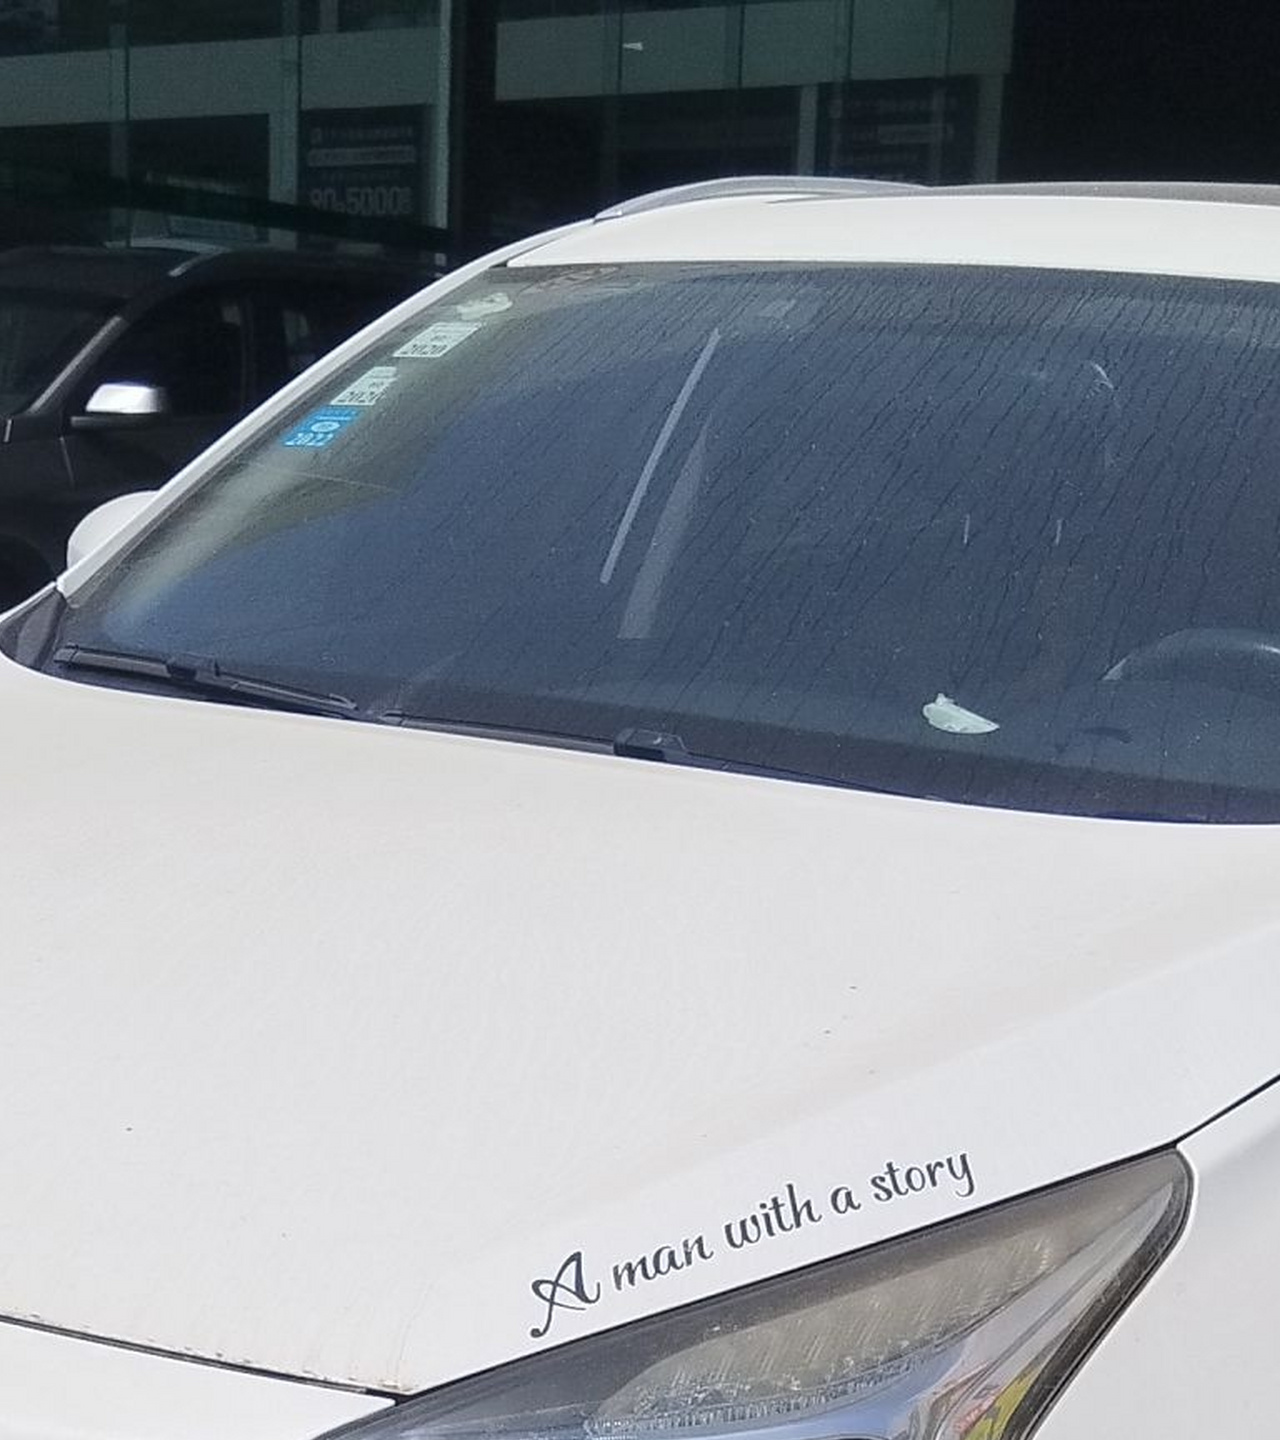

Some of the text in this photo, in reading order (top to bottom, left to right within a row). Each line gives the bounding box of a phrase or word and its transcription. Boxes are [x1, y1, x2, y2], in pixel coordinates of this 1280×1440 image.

[530, 1149, 976, 1338] A man with a story
